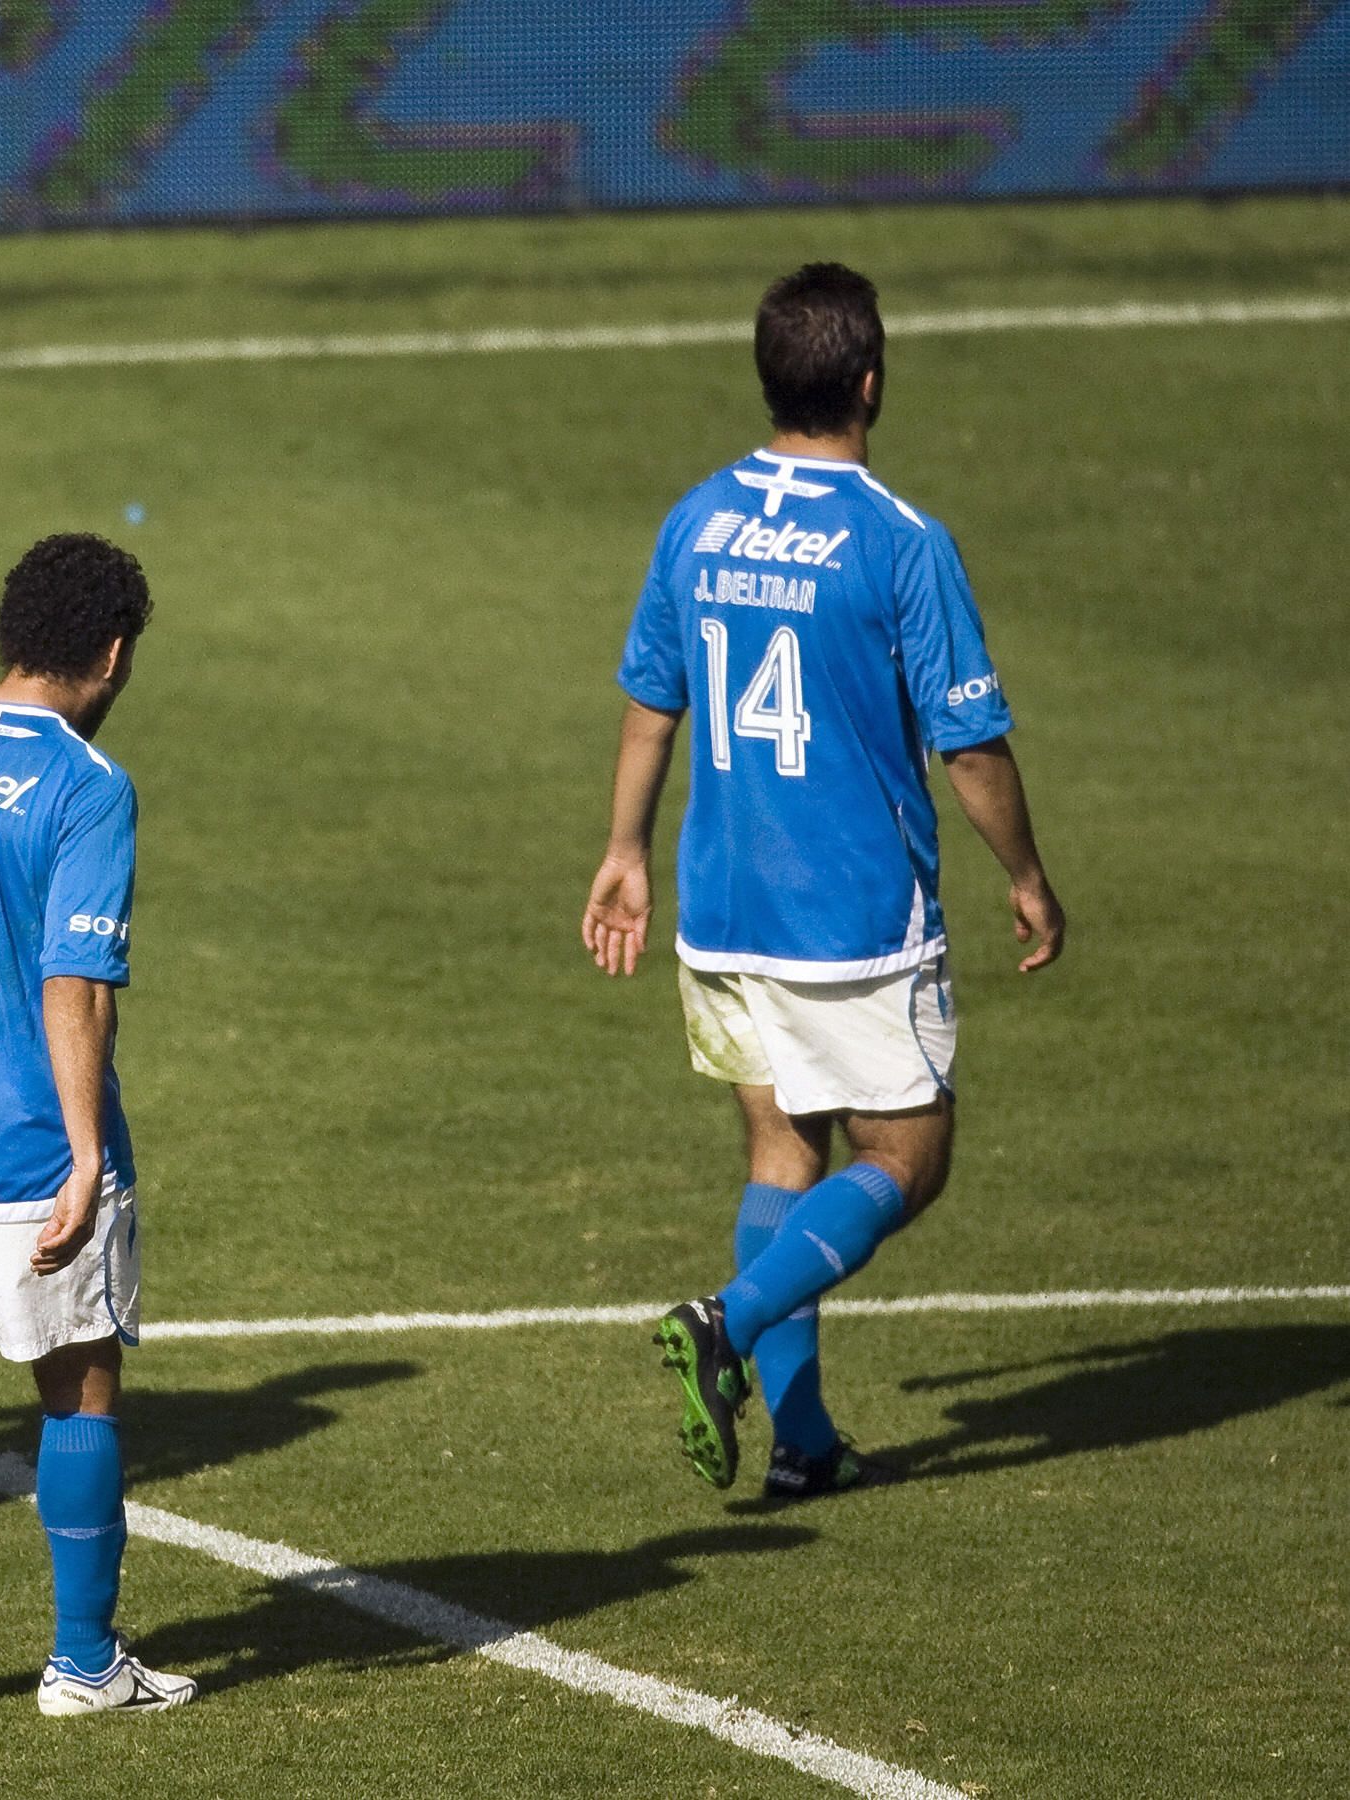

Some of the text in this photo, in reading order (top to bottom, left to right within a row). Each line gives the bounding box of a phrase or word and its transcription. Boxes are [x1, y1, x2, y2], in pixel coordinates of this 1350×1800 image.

[729, 517, 851, 566] telcel
[701, 618, 811, 777] 14
[60, 1688, 94, 1708] ROMINA
